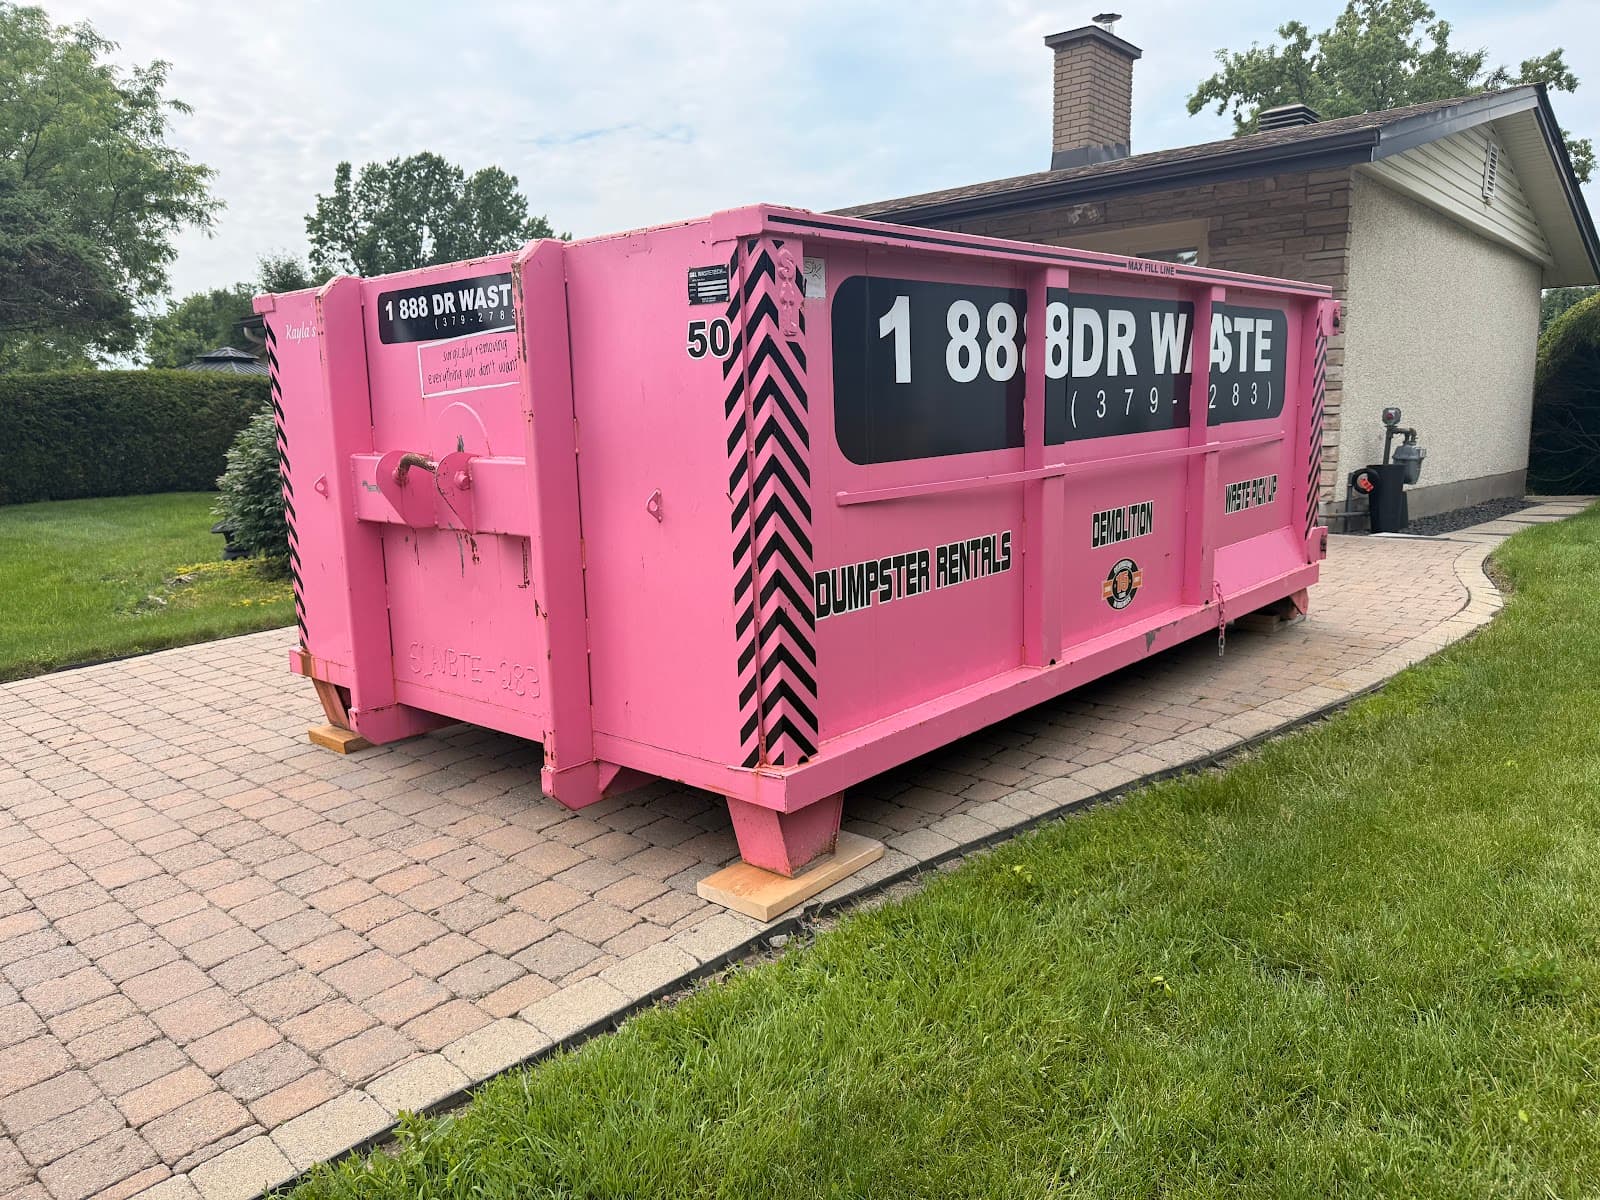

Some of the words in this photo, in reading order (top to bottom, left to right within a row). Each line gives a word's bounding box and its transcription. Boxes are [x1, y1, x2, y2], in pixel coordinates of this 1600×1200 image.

[1128, 260, 1143, 271] MAX
[1145, 263, 1158, 273] FILL
[1160, 265, 1174, 275] LINE
[385, 301, 393, 320] 1
[399, 296, 428, 320] 888
[432, 292, 456, 316] DR
[458, 284, 513, 312] WAST
[285, 321, 317, 344] Kayla's
[475, 339, 508, 358] removing
[687, 318, 731, 359] 50
[879, 296, 911, 383] 1
[1071, 308, 1138, 377] DR
[1151, 312, 1273, 374] WASTE
[428, 367, 462, 388] everything
[465, 367, 476, 384] you
[479, 360, 496, 377] don't
[498, 359, 517, 374] want
[1225, 480, 1251, 515] WASTE
[1252, 476, 1266, 508] PICK
[1267, 474, 1279, 503] UP
[1091, 500, 1154, 549] DEMOLITION
[814, 548, 931, 621] DUMPSTER
[936, 530, 1012, 589] RENTALS
[1116, 570, 1129, 593] 15
